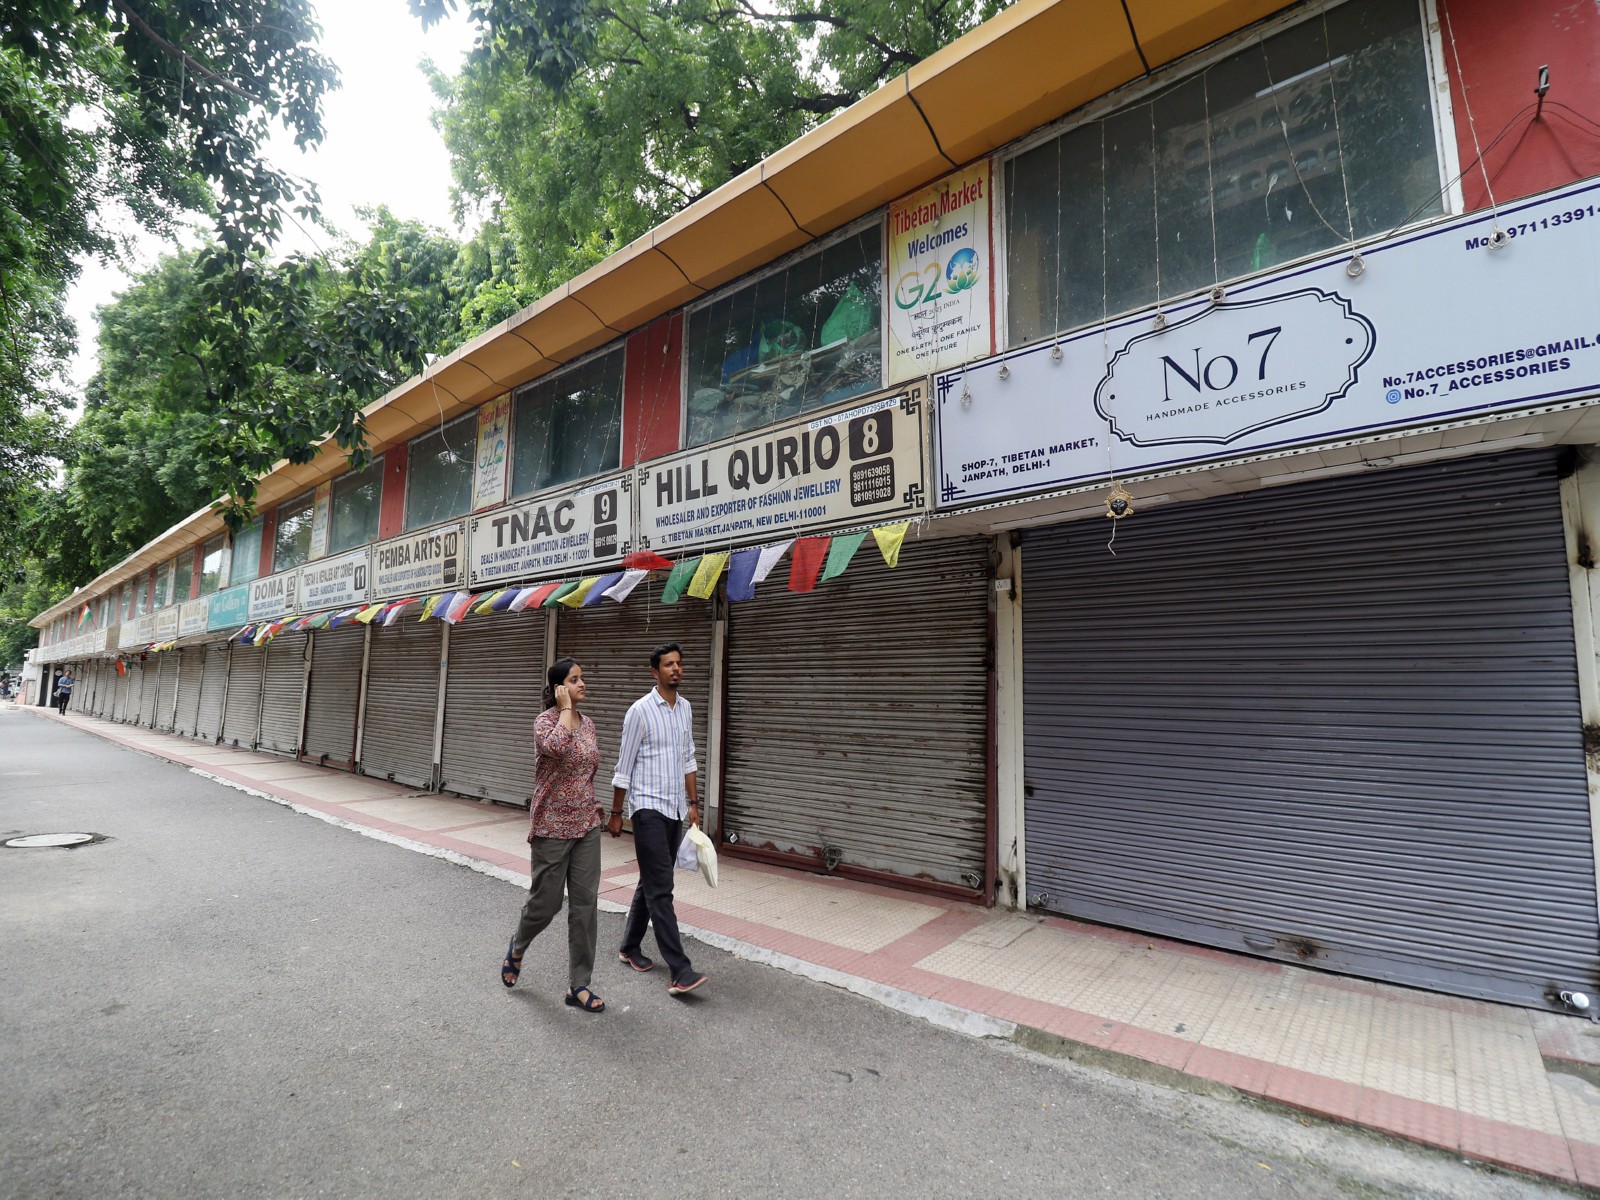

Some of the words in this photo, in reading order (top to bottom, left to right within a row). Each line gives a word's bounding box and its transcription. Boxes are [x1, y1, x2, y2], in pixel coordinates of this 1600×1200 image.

[894, 202, 937, 236] Tibetan
[940, 176, 983, 216] Market
[908, 222, 968, 259] Welcomes
[943, 298, 960, 309] INDIA
[896, 348, 910, 356] ONE
[912, 340, 933, 352] EARTH
[940, 333, 954, 342] ONE
[956, 324, 982, 337] FAMILY
[916, 351, 930, 360] ONE
[932, 342, 958, 355] FUTURE
[1158, 346, 1238, 402] No
[1248, 326, 1282, 381] 7
[1404, 358, 1571, 400] No.7_ACCESSORIES
[1146, 402, 1210, 422] HANDMADE
[1215, 381, 1307, 408] ACCESSORIES
[810, 420, 822, 430] GST
[824, 418, 833, 426] NO
[656, 458, 718, 508] HILL
[728, 424, 841, 492] QURIO
[862, 418, 879, 454] 8
[961, 459, 998, 472] SHOP-7,
[1001, 448, 1044, 464] TIBETAN
[1049, 438, 1099, 454] MARKET,
[962, 468, 1009, 483] JANPATH,
[1012, 459, 1051, 474] DELHI-1
[853, 464, 891, 482] 9891639058
[853, 476, 891, 492] 9811116015
[655, 509, 695, 528] WHOLESALER
[696, 506, 710, 520] AND
[711, 500, 747, 517] EXPORTER
[748, 498, 757, 510] OF
[758, 490, 792, 508] FASHION
[793, 478, 841, 502] JEWELLERY
[492, 499, 575, 548] TNAC
[601, 494, 610, 520] 9
[662, 536, 668, 545] 8,
[668, 528, 694, 543] TIBETAN
[756, 514, 772, 527] NEW
[774, 505, 826, 524] DELHI-110001
[379, 543, 410, 571] PEMBA
[413, 535, 442, 563] ARTS
[445, 534, 456, 556] 10
[481, 554, 494, 565] DEALS
[494, 553, 499, 562] IN
[499, 546, 526, 561] HANDICRAFT
[560, 532, 589, 549] JEWELLERY
[485, 566, 502, 577] TIBETAN
[502, 562, 520, 575] MARKET,
[521, 558, 542, 571] JANPATH,
[542, 556, 553, 567] NEW
[554, 554, 568, 564] DELHI
[572, 549, 590, 561] 110001
[254, 578, 284, 602] DOMA
[356, 567, 364, 590] 11
